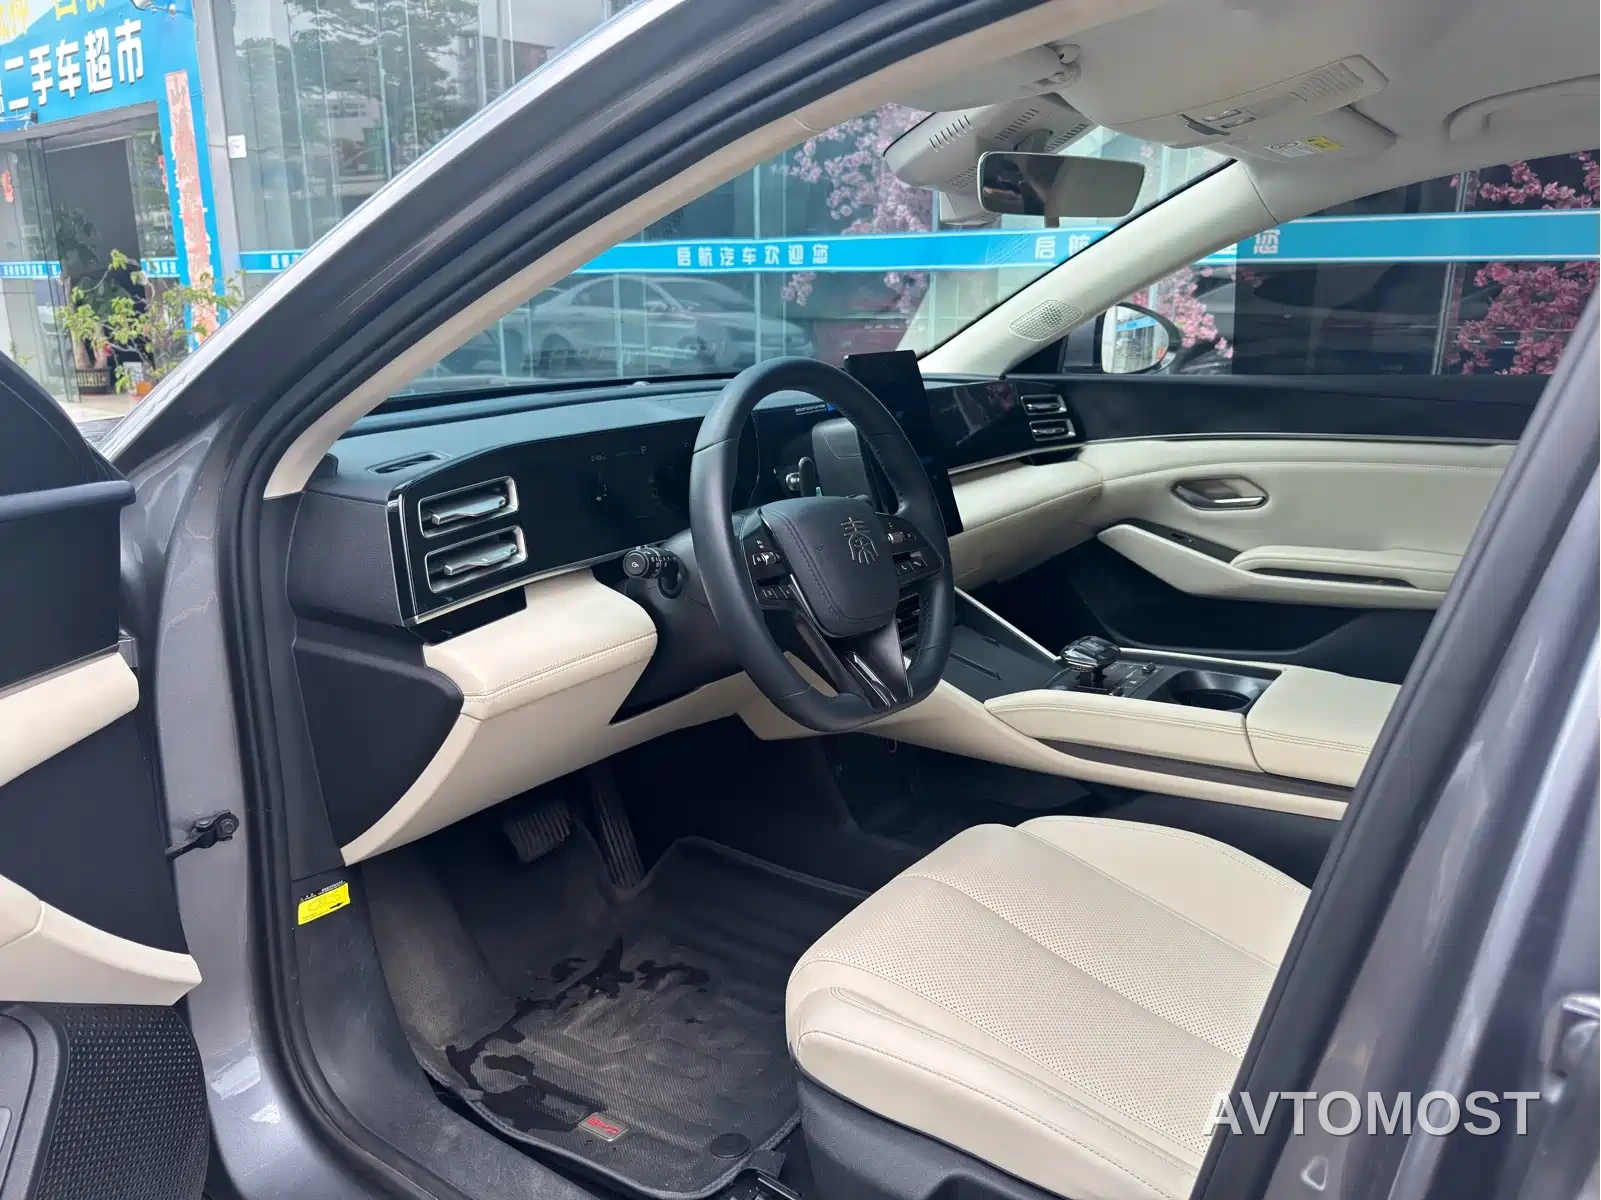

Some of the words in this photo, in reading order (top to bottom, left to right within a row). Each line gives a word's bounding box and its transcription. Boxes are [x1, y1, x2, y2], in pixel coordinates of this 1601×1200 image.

[0, 18, 144, 113] 二手车超市
[676, 243, 829, 267] 启航汽车欢迎您
